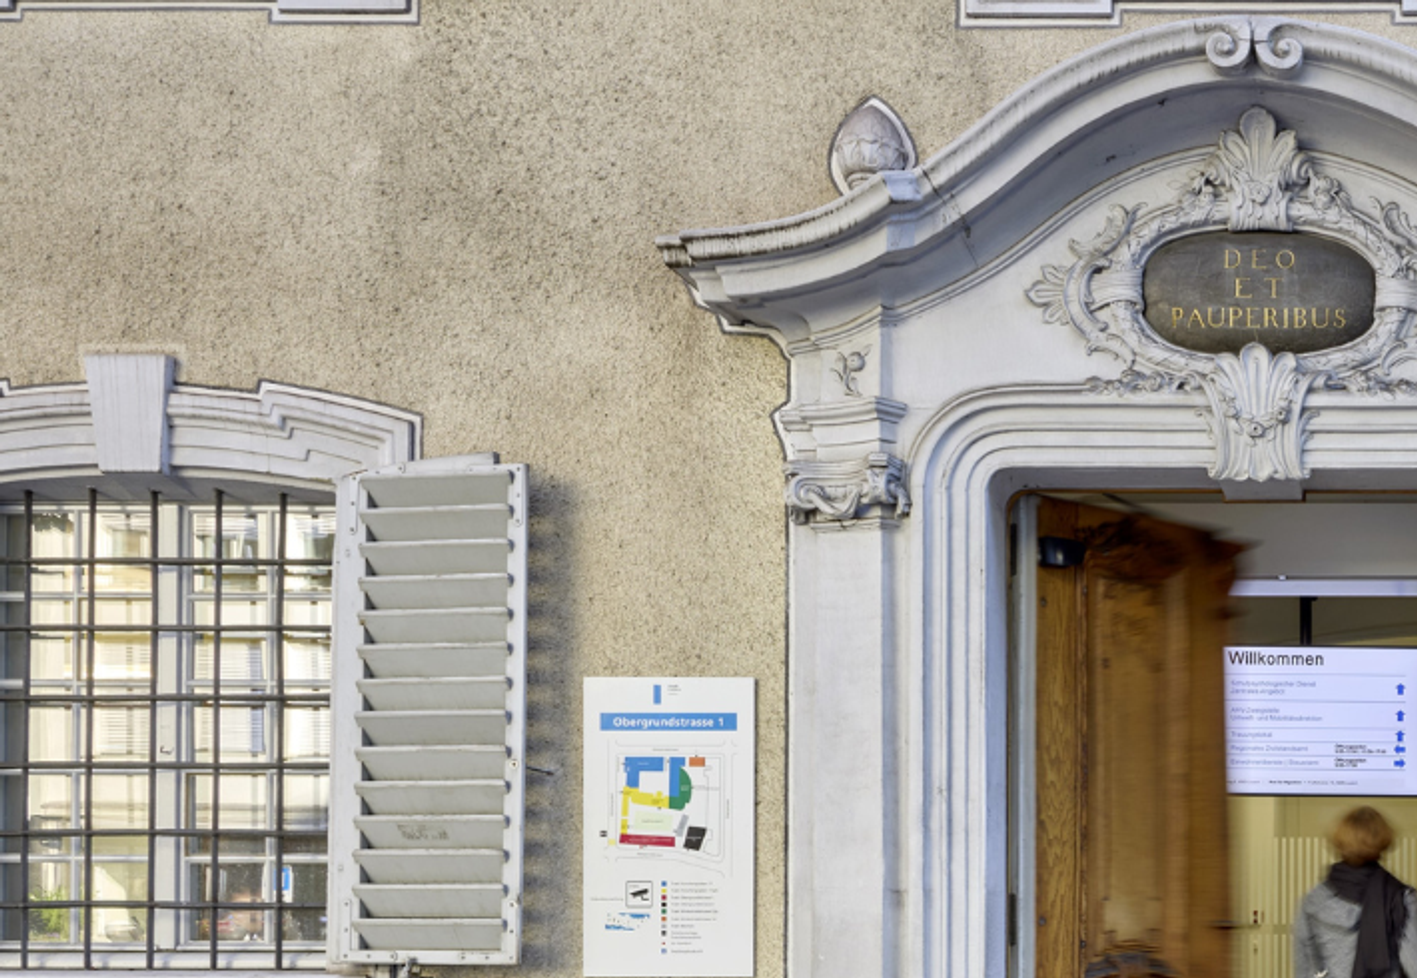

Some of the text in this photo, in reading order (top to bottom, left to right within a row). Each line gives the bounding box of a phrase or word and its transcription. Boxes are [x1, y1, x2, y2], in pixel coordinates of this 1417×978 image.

[1223, 249, 1296, 270] DEO
[1234, 277, 1285, 299] ET
[1170, 306, 1347, 329] PAUPERIBUS
[1228, 650, 1325, 666] Willkommen
[613, 716, 724, 729] Obergrundstrasse 1
